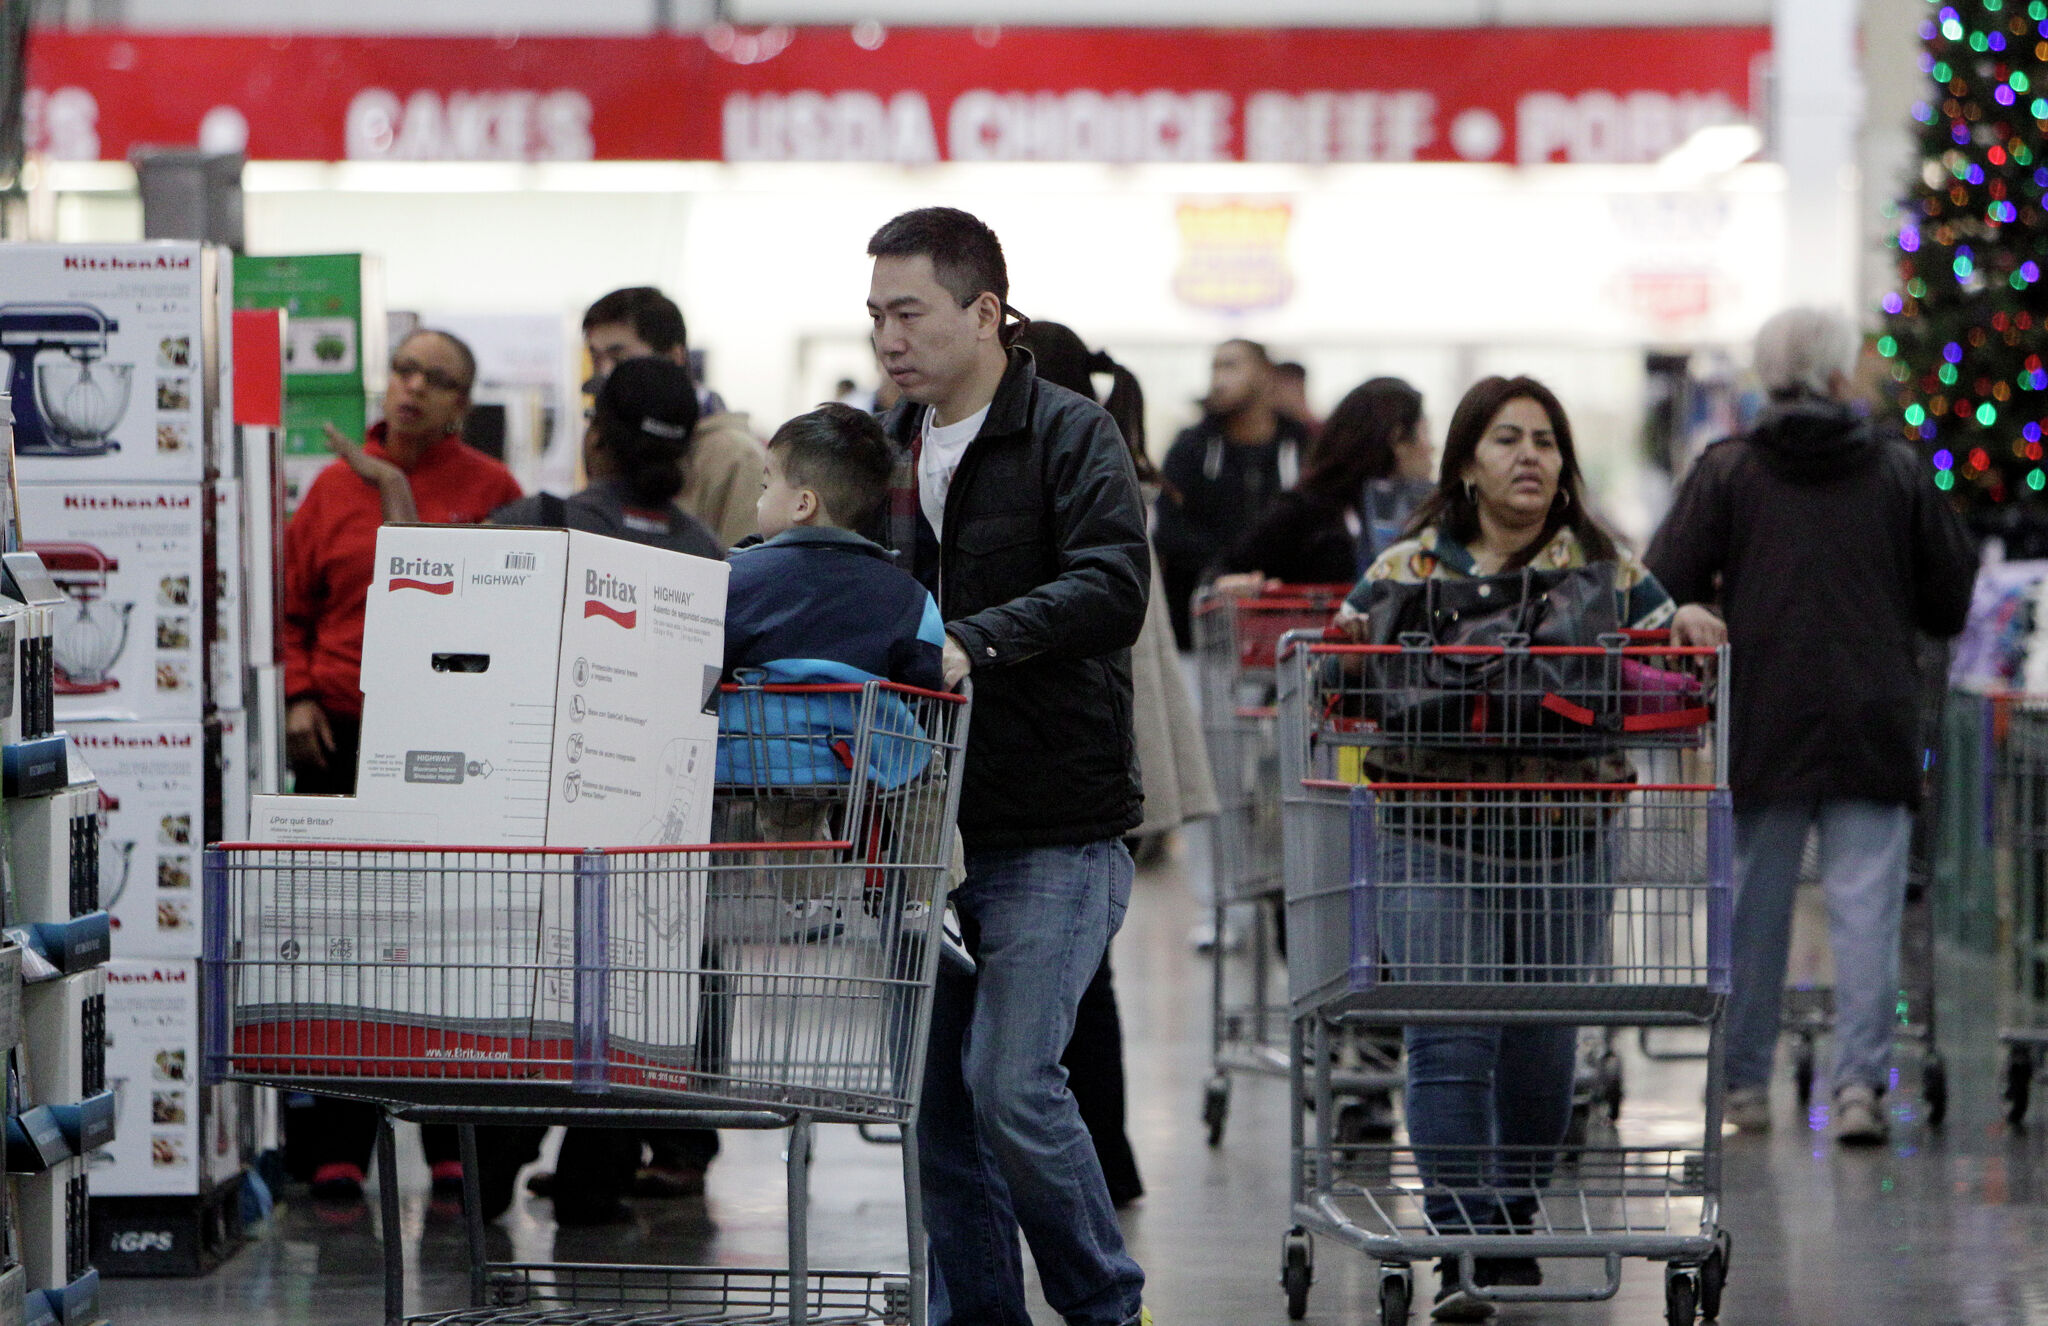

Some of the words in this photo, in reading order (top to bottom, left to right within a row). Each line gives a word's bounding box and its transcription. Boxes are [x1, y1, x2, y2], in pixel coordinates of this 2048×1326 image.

[346, 86, 595, 160] CAKES
[722, 90, 940, 162] USDA
[948, 89, 1234, 162] CHOICE
[1244, 90, 1438, 162] BEEF
[64, 255, 190, 270] KitchenAid
[64, 495, 190, 509] KitchenAid
[389, 556, 455, 577] Britax
[471, 573, 527, 587] HIGHWAY
[585, 568, 637, 604] Britax
[653, 585, 692, 606] HIGHWAY
[270, 816, 288, 824] ¿Por
[290, 817, 305, 827] qué
[307, 817, 334, 826] Britax?
